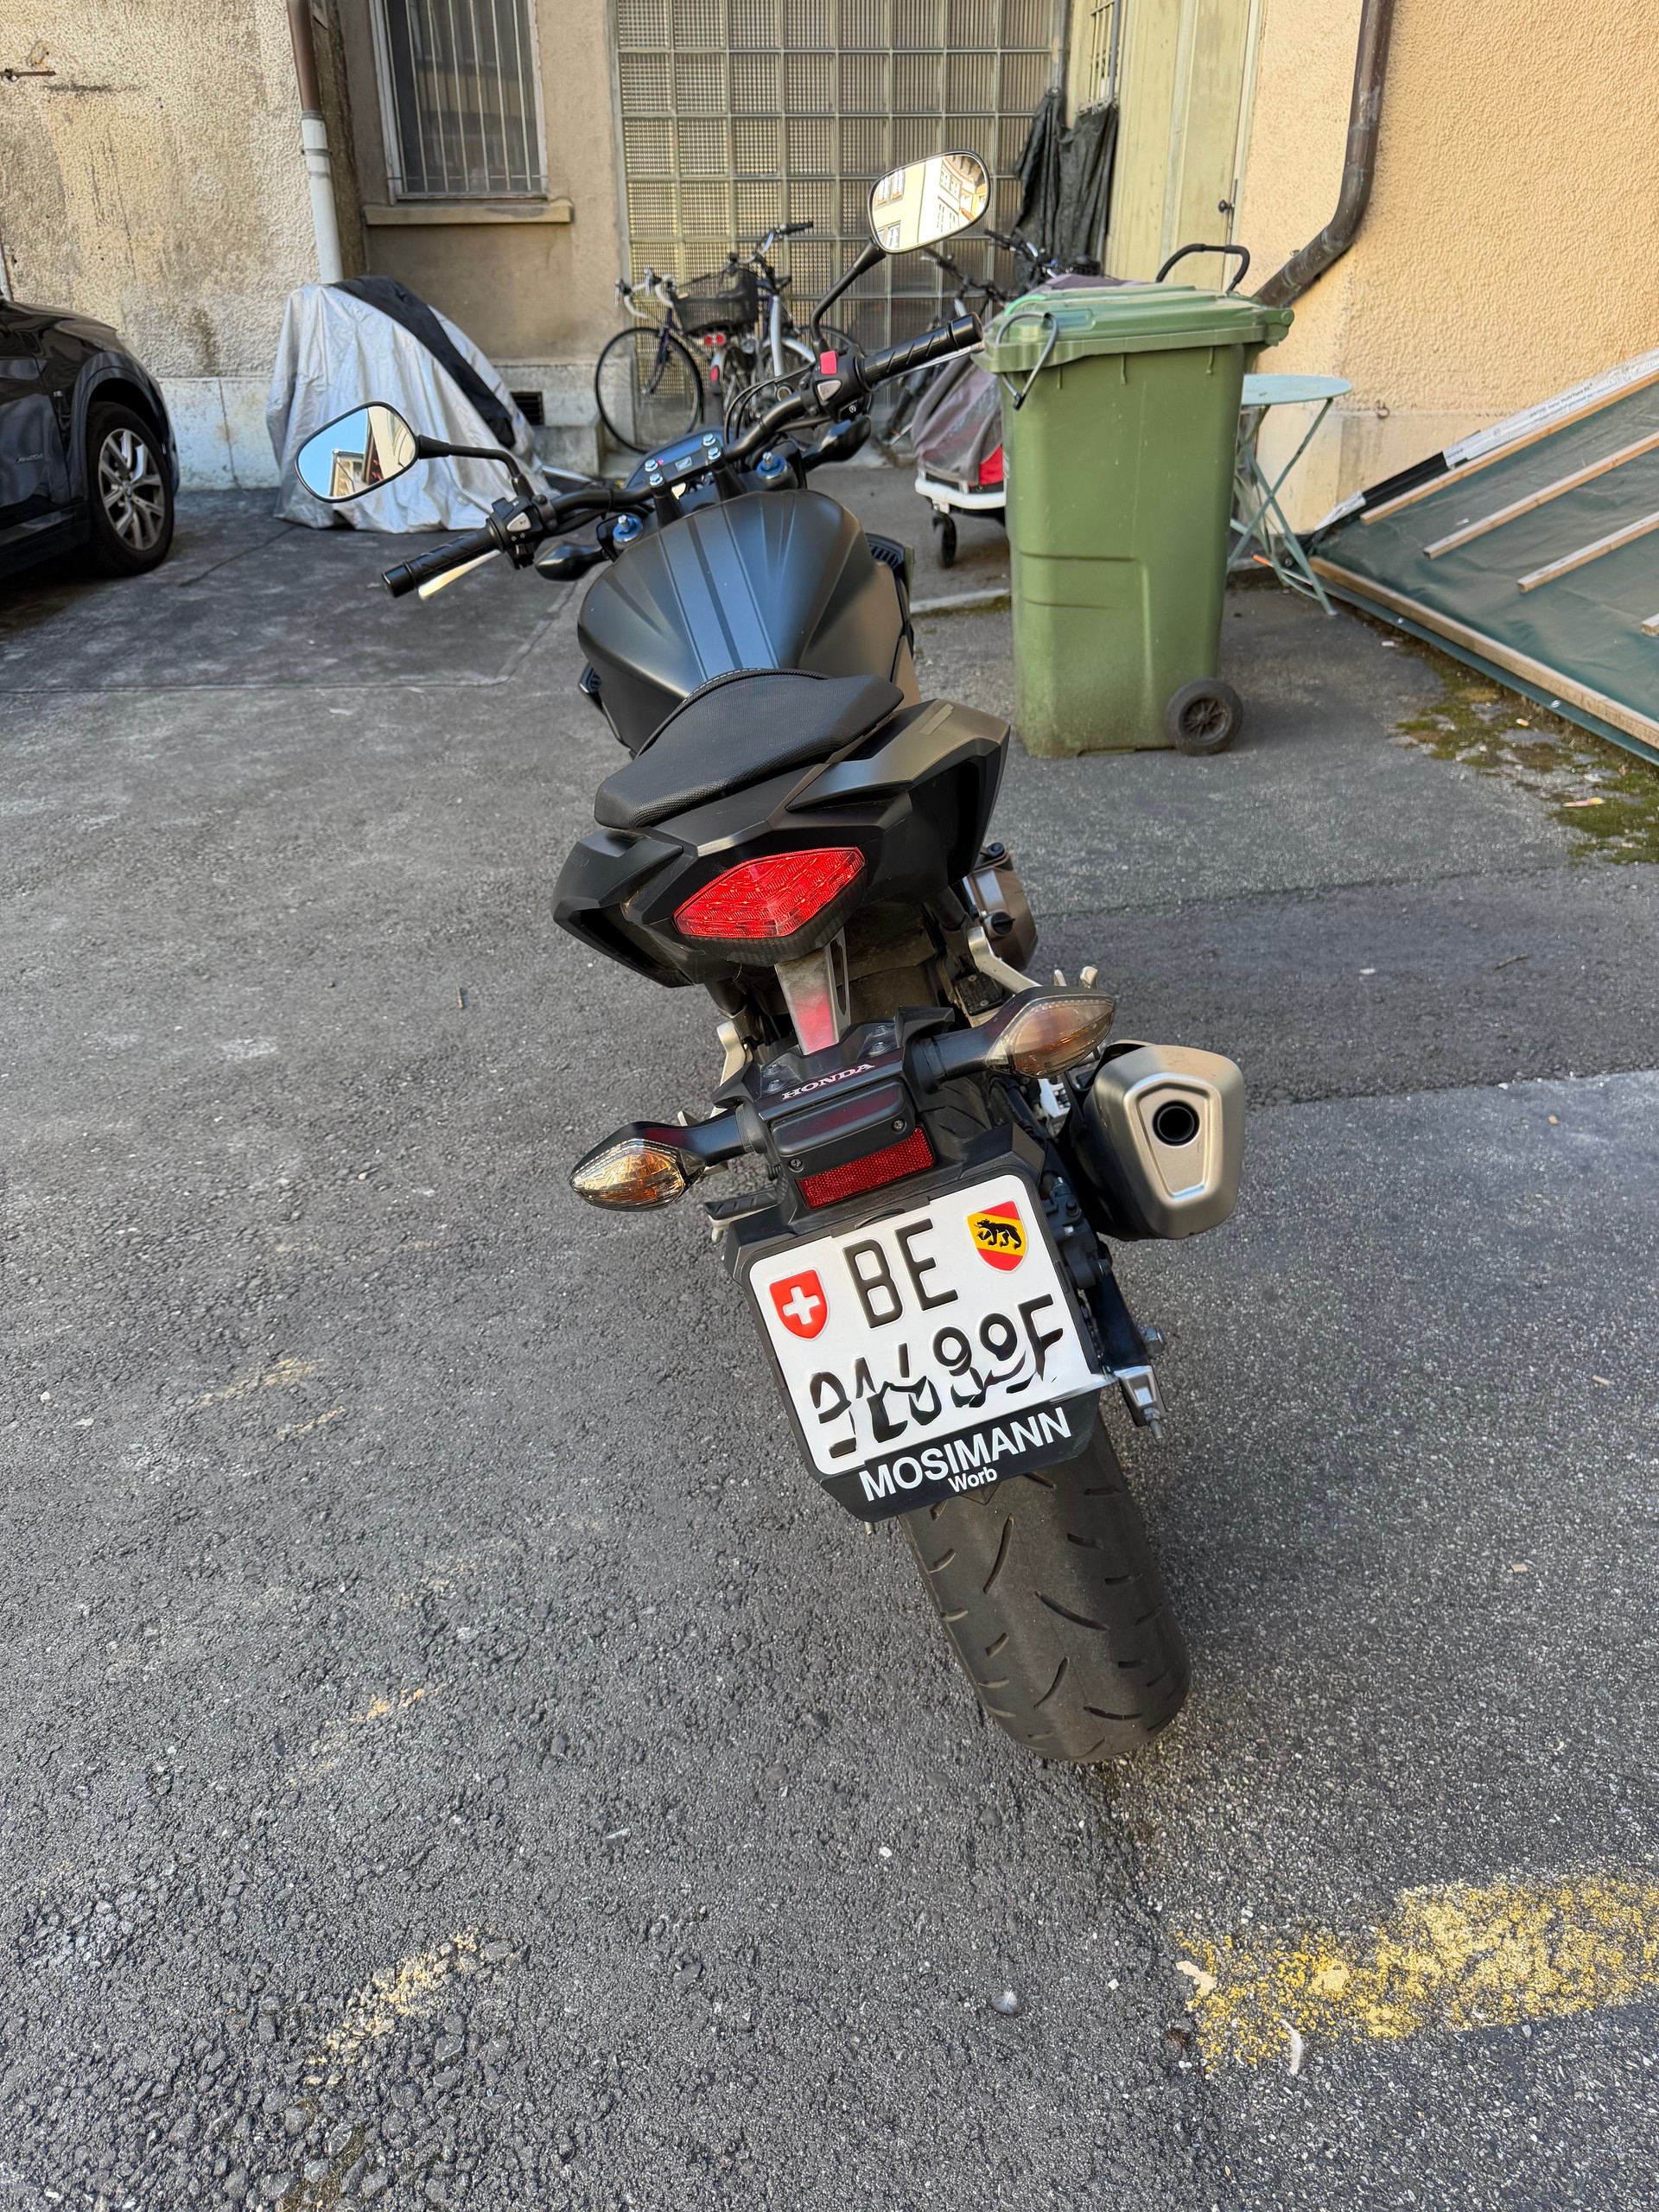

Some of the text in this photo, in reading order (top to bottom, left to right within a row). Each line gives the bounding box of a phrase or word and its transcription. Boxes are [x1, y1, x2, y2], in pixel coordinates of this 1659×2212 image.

[781, 1063, 875, 1100] HONDA
[842, 1217, 959, 1329] BE
[859, 1407, 1071, 1502] MOSIMANN
[947, 1466, 998, 1493] Worb
